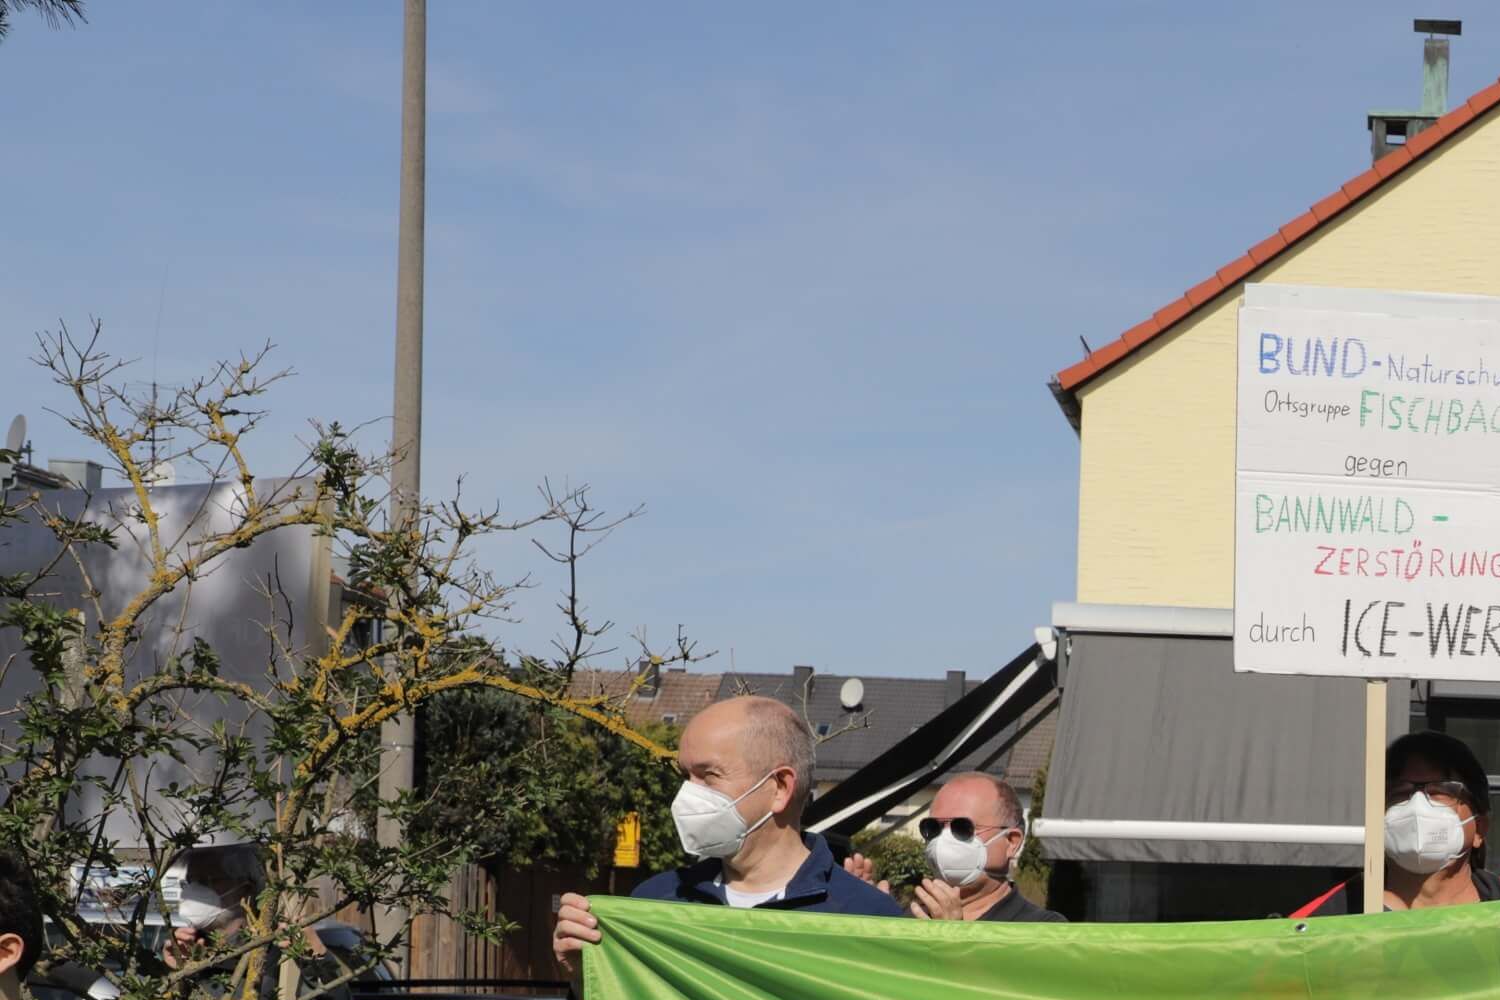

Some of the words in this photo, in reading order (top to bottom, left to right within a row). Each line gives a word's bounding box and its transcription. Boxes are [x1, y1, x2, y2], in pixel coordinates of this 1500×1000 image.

[1264, 389, 1351, 423] Ortsgruppe
[1344, 454, 1409, 477] gegen
[1249, 611, 1315, 644] durch
